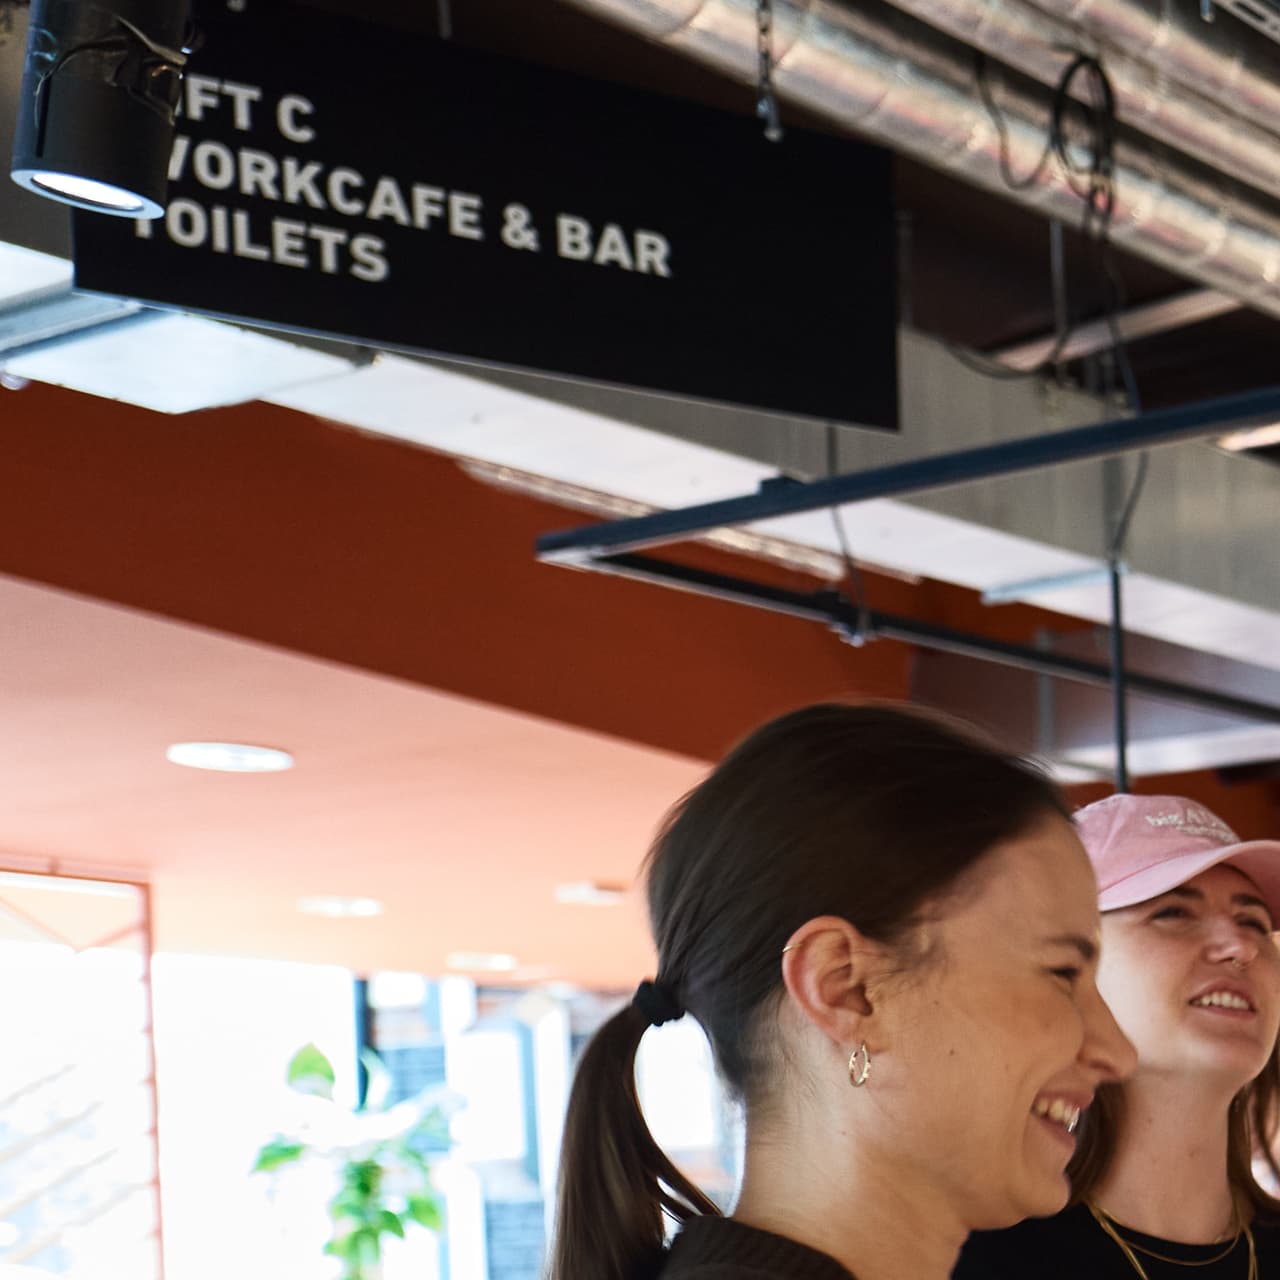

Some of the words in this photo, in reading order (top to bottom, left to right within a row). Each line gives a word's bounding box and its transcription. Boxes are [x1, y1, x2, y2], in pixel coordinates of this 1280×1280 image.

[276, 93, 316, 143] C
[501, 203, 539, 251] &
[556, 213, 672, 278] BAR
